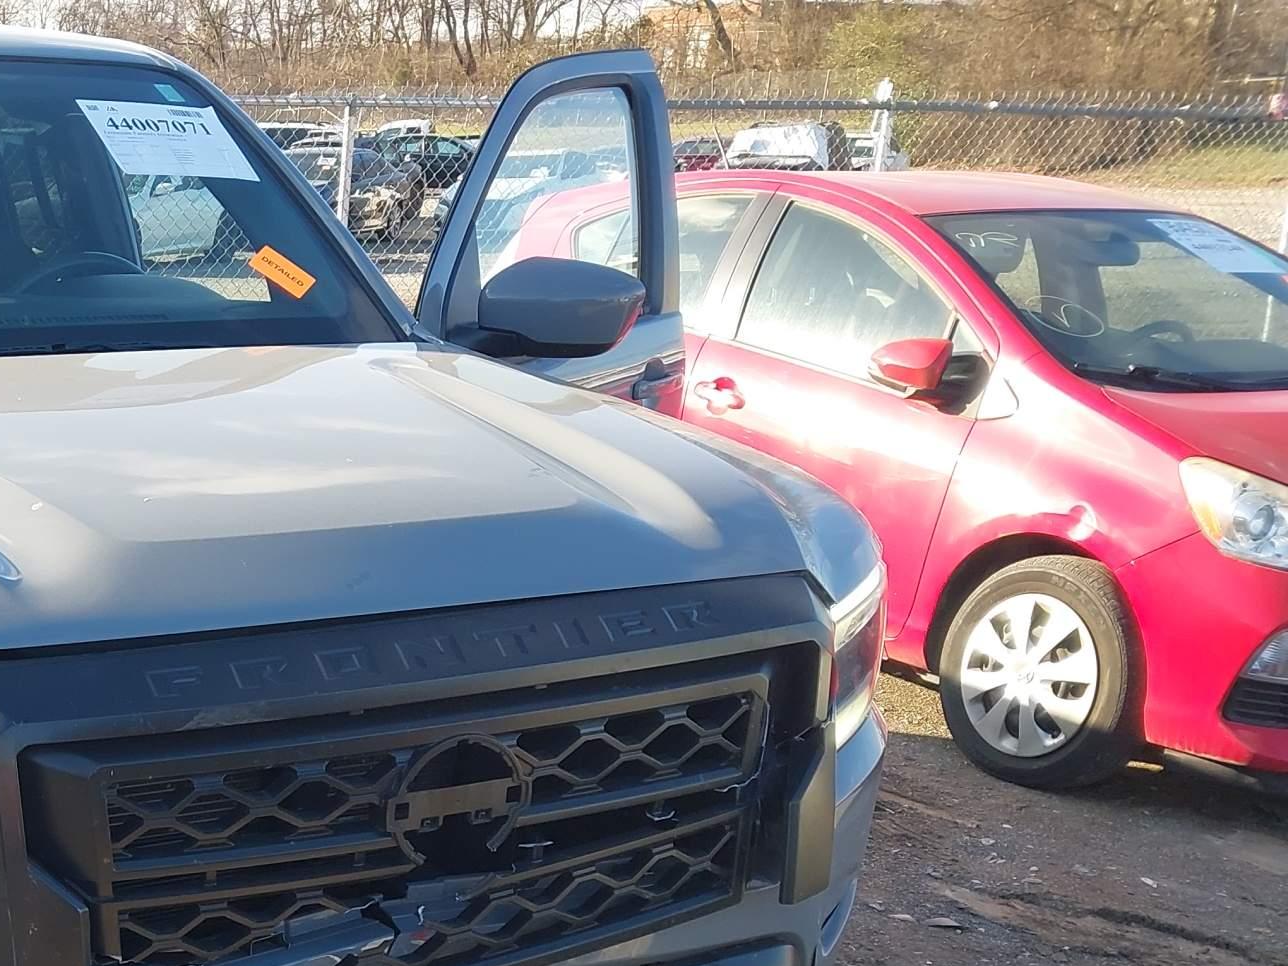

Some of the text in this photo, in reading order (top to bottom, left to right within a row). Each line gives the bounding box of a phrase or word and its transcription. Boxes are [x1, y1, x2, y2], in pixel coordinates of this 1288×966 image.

[106, 117, 212, 136] 44007071
[261, 255, 305, 287] DETAILED
[143, 599, 721, 699] FRONTIER
